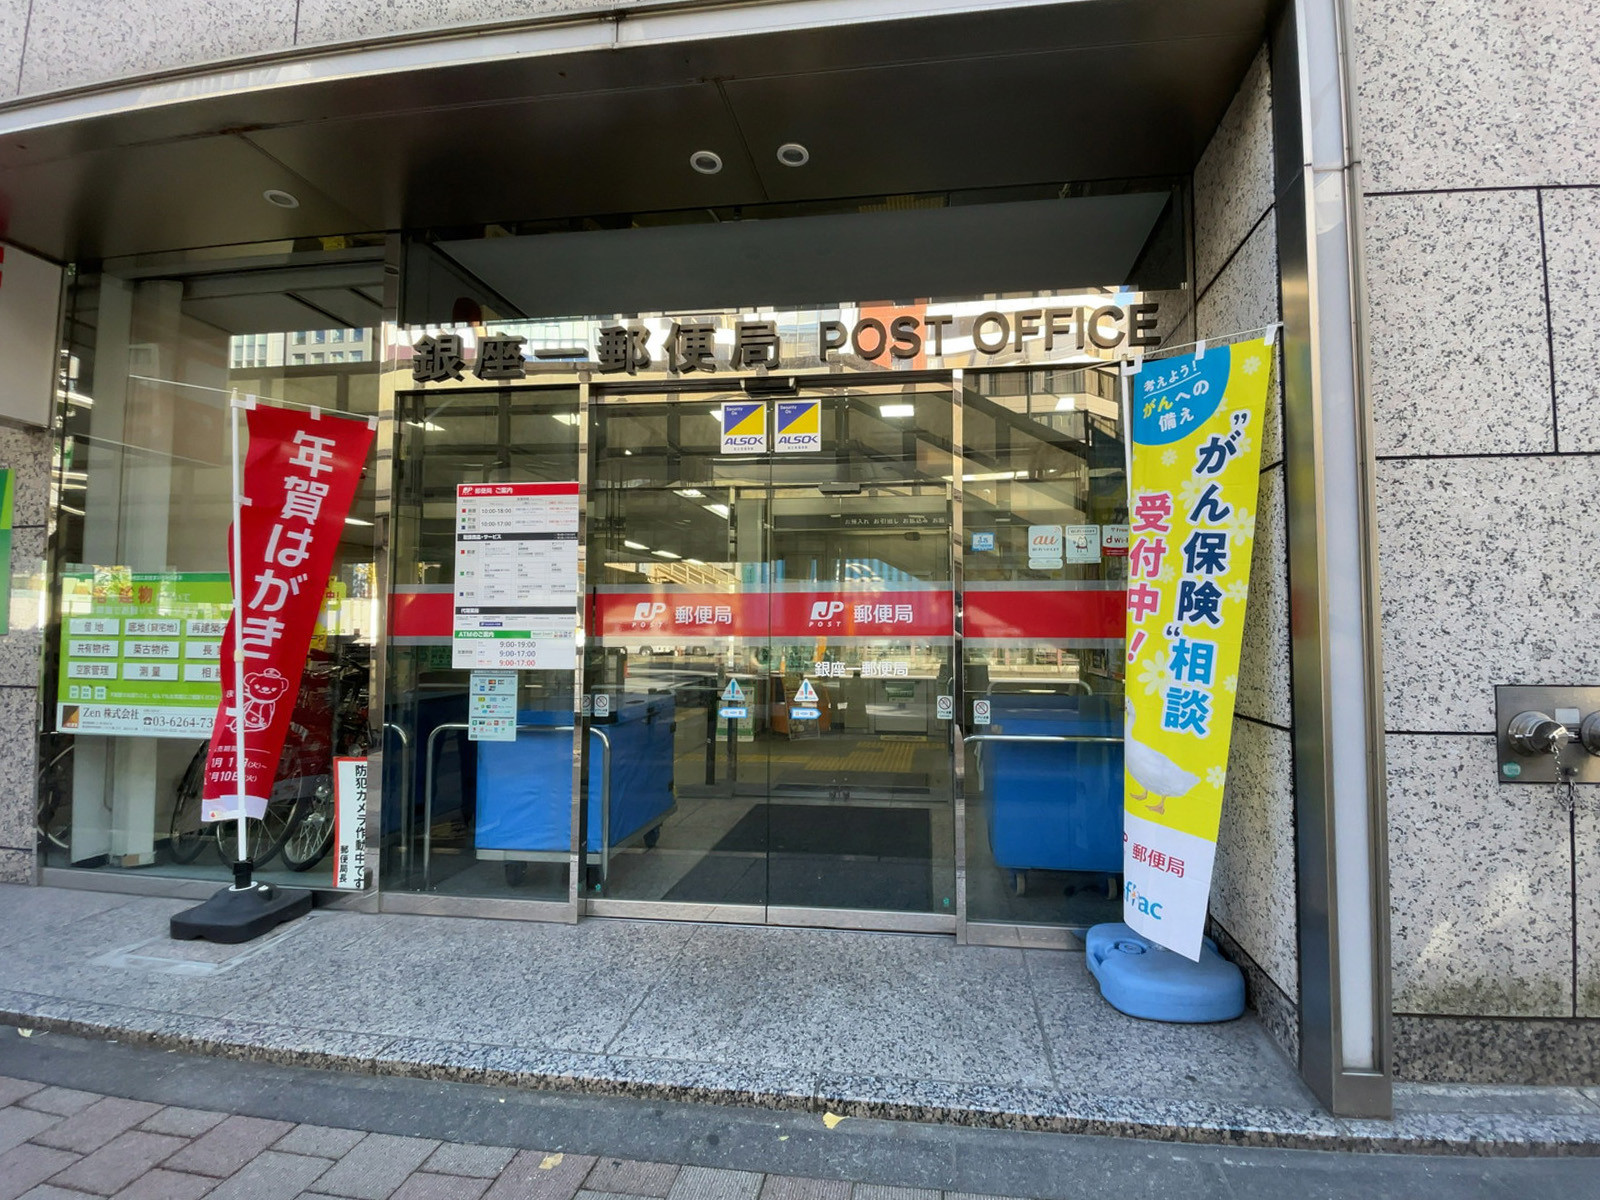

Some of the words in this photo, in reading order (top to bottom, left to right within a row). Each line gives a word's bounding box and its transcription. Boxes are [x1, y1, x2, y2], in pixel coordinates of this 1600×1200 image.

[412, 320, 781, 383] 銀座一郵便局
[819, 315, 953, 362] POST
[972, 303, 1161, 356] OFFICE
[1142, 379, 1200, 419] がんへの
[1158, 407, 1194, 432] 備え
[725, 437, 764, 446] ALSOK
[778, 435, 818, 445] ALSOK
[243, 430, 337, 660] 年賀はがき
[1032, 535, 1056, 545] au
[675, 605, 732, 625] 郵便局
[854, 604, 914, 625] 郵便局
[809, 620, 843, 628] POST
[77, 643, 110, 655] 共有物件
[139, 666, 161, 677] 測量
[499, 659, 536, 667] 9:00-17:00
[814, 660, 909, 678] 銀座一郵便局
[83, 707, 101, 718] Zen
[104, 707, 140, 720] 株式会社
[339, 844, 349, 884] 郵便局長
[1132, 842, 1185, 878] 郵便局
